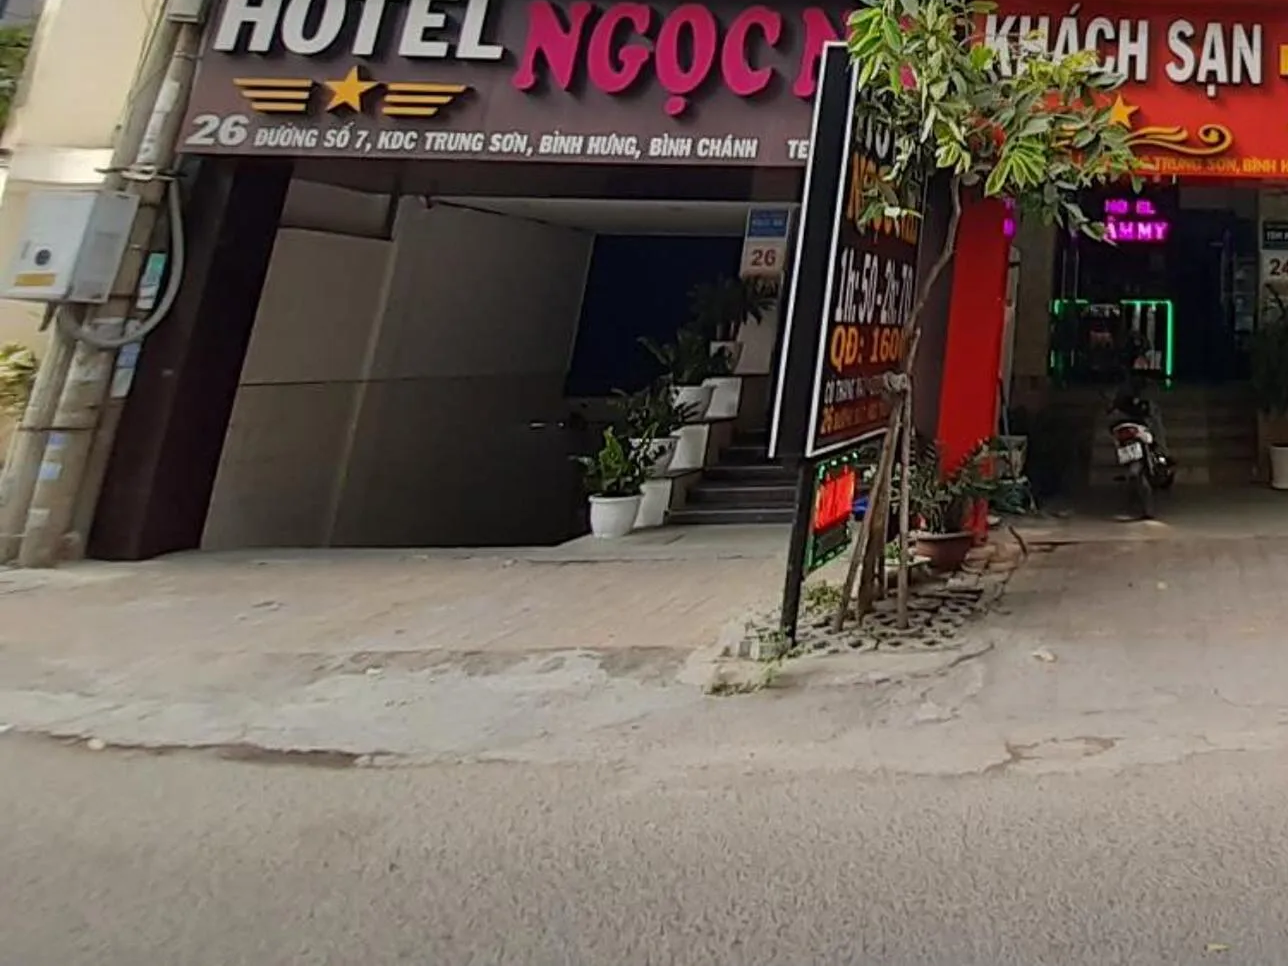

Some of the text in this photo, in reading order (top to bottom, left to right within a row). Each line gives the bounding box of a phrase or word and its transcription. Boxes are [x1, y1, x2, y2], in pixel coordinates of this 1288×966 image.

[984, 3, 1149, 82] KHÁCH
[1165, 19, 1262, 98] SẠN
[186, 114, 249, 146] 26
[323, 121, 355, 148] SỐ
[355, 131, 371, 153] 7,
[377, 131, 418, 151] KDC
[424, 132, 484, 152] TRUNG
[539, 130, 582, 155] BÌNH
[649, 133, 692, 157] BÌNH
[697, 134, 758, 159] CHÁNH
[751, 249, 776, 267] 26
